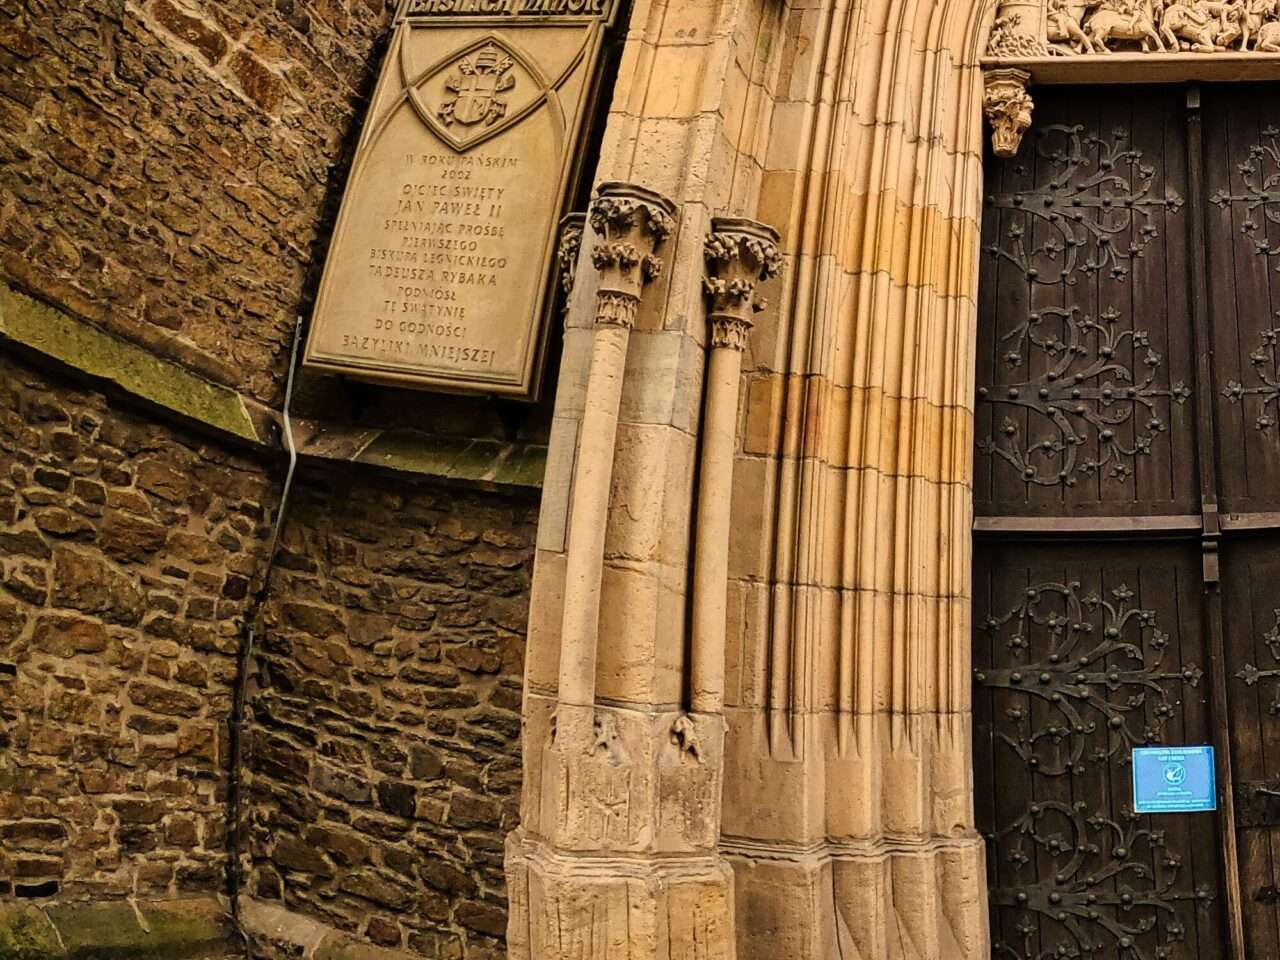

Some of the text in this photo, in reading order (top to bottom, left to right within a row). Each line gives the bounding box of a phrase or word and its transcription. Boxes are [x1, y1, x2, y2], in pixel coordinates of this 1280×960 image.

[440, 169, 472, 181] 2002
[397, 199, 502, 218] JAN PAWEŁ II
[441, 270, 497, 286] RYBAKA
[374, 318, 394, 331] DO
